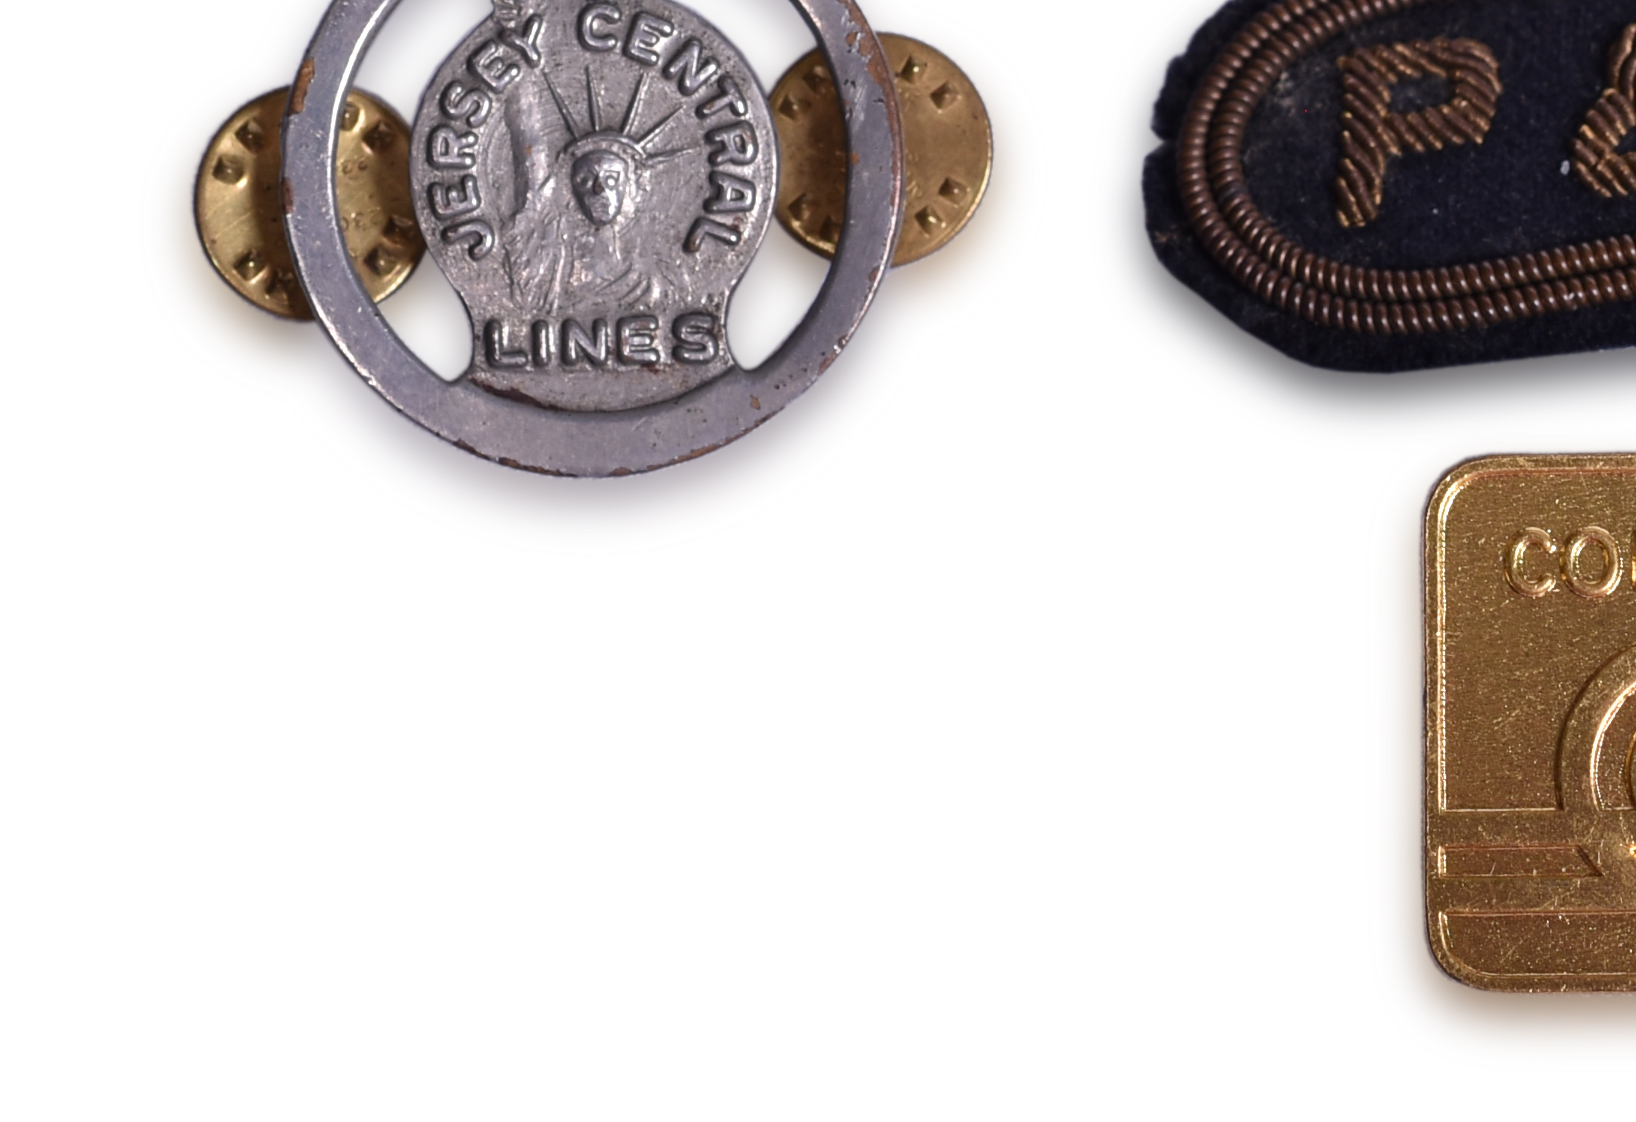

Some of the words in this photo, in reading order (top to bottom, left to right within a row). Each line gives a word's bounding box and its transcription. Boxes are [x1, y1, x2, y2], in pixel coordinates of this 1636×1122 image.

[424, 12, 546, 262] JERSEY
[576, 1, 762, 254] CENTRAL
[1335, 36, 1502, 228] P
[483, 312, 722, 370] LINES
